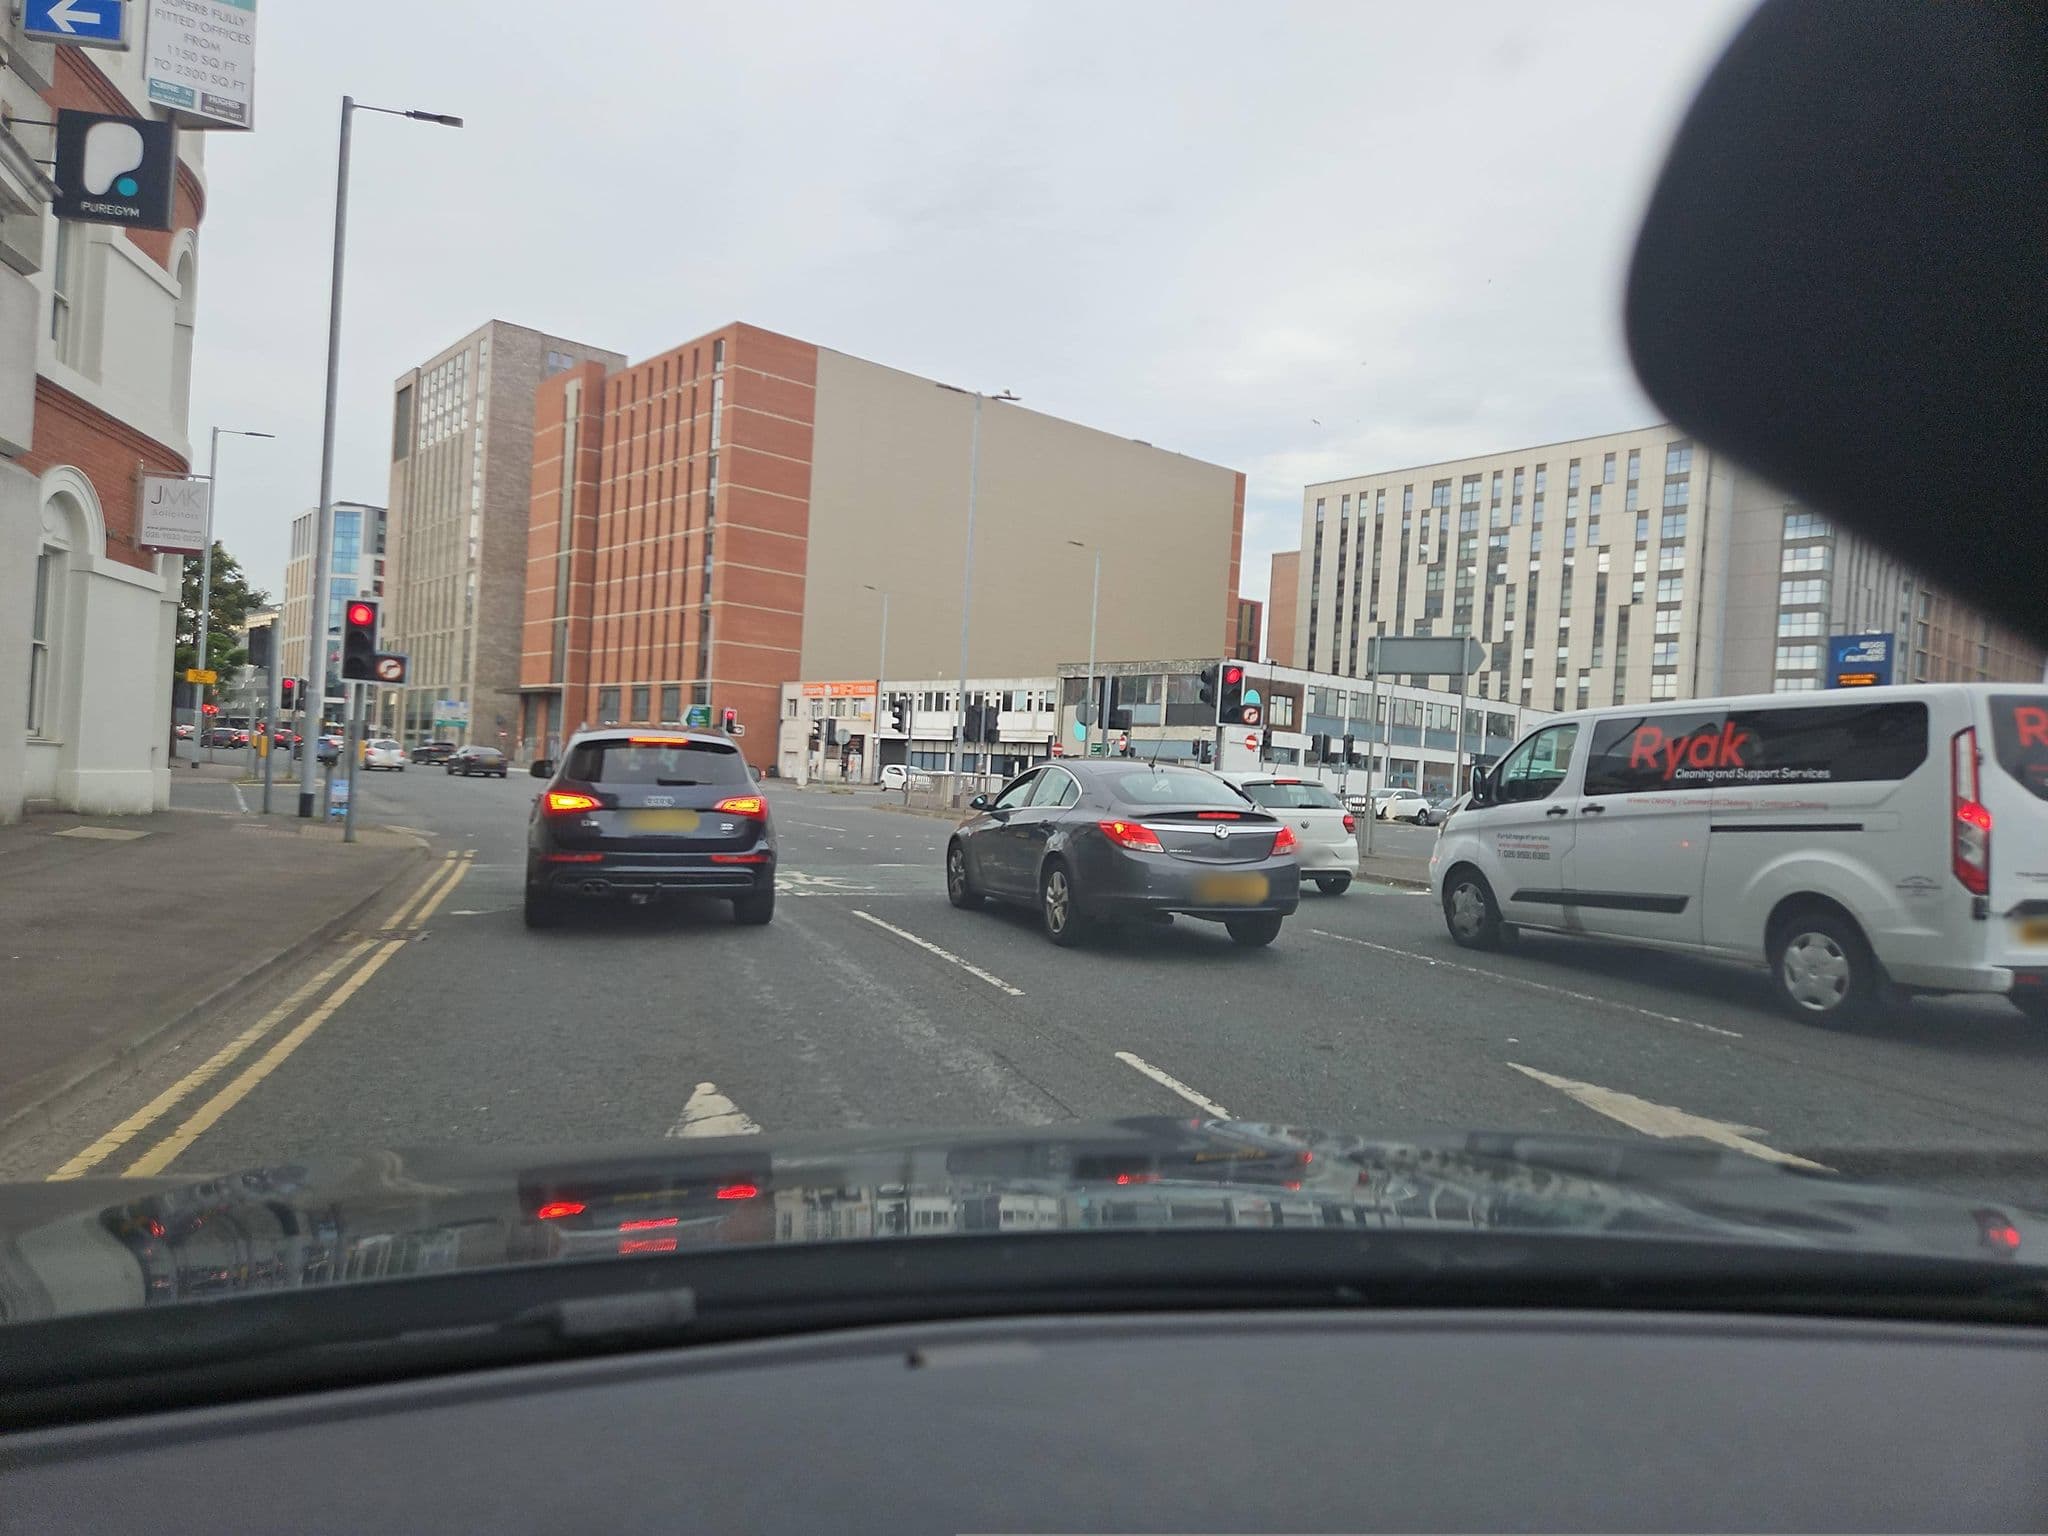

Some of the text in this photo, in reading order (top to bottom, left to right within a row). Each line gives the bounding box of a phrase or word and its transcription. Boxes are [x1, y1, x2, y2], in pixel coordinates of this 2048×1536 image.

[184, 32, 221, 52] FROM
[200, 21, 252, 46] OFFICES
[153, 57, 171, 71] TO
[80, 200, 140, 218] PUREGYM
[150, 485, 202, 509] JMK
[1629, 720, 1748, 781] Ryak
[1675, 766, 1831, 782] Cleaning and Support Services
